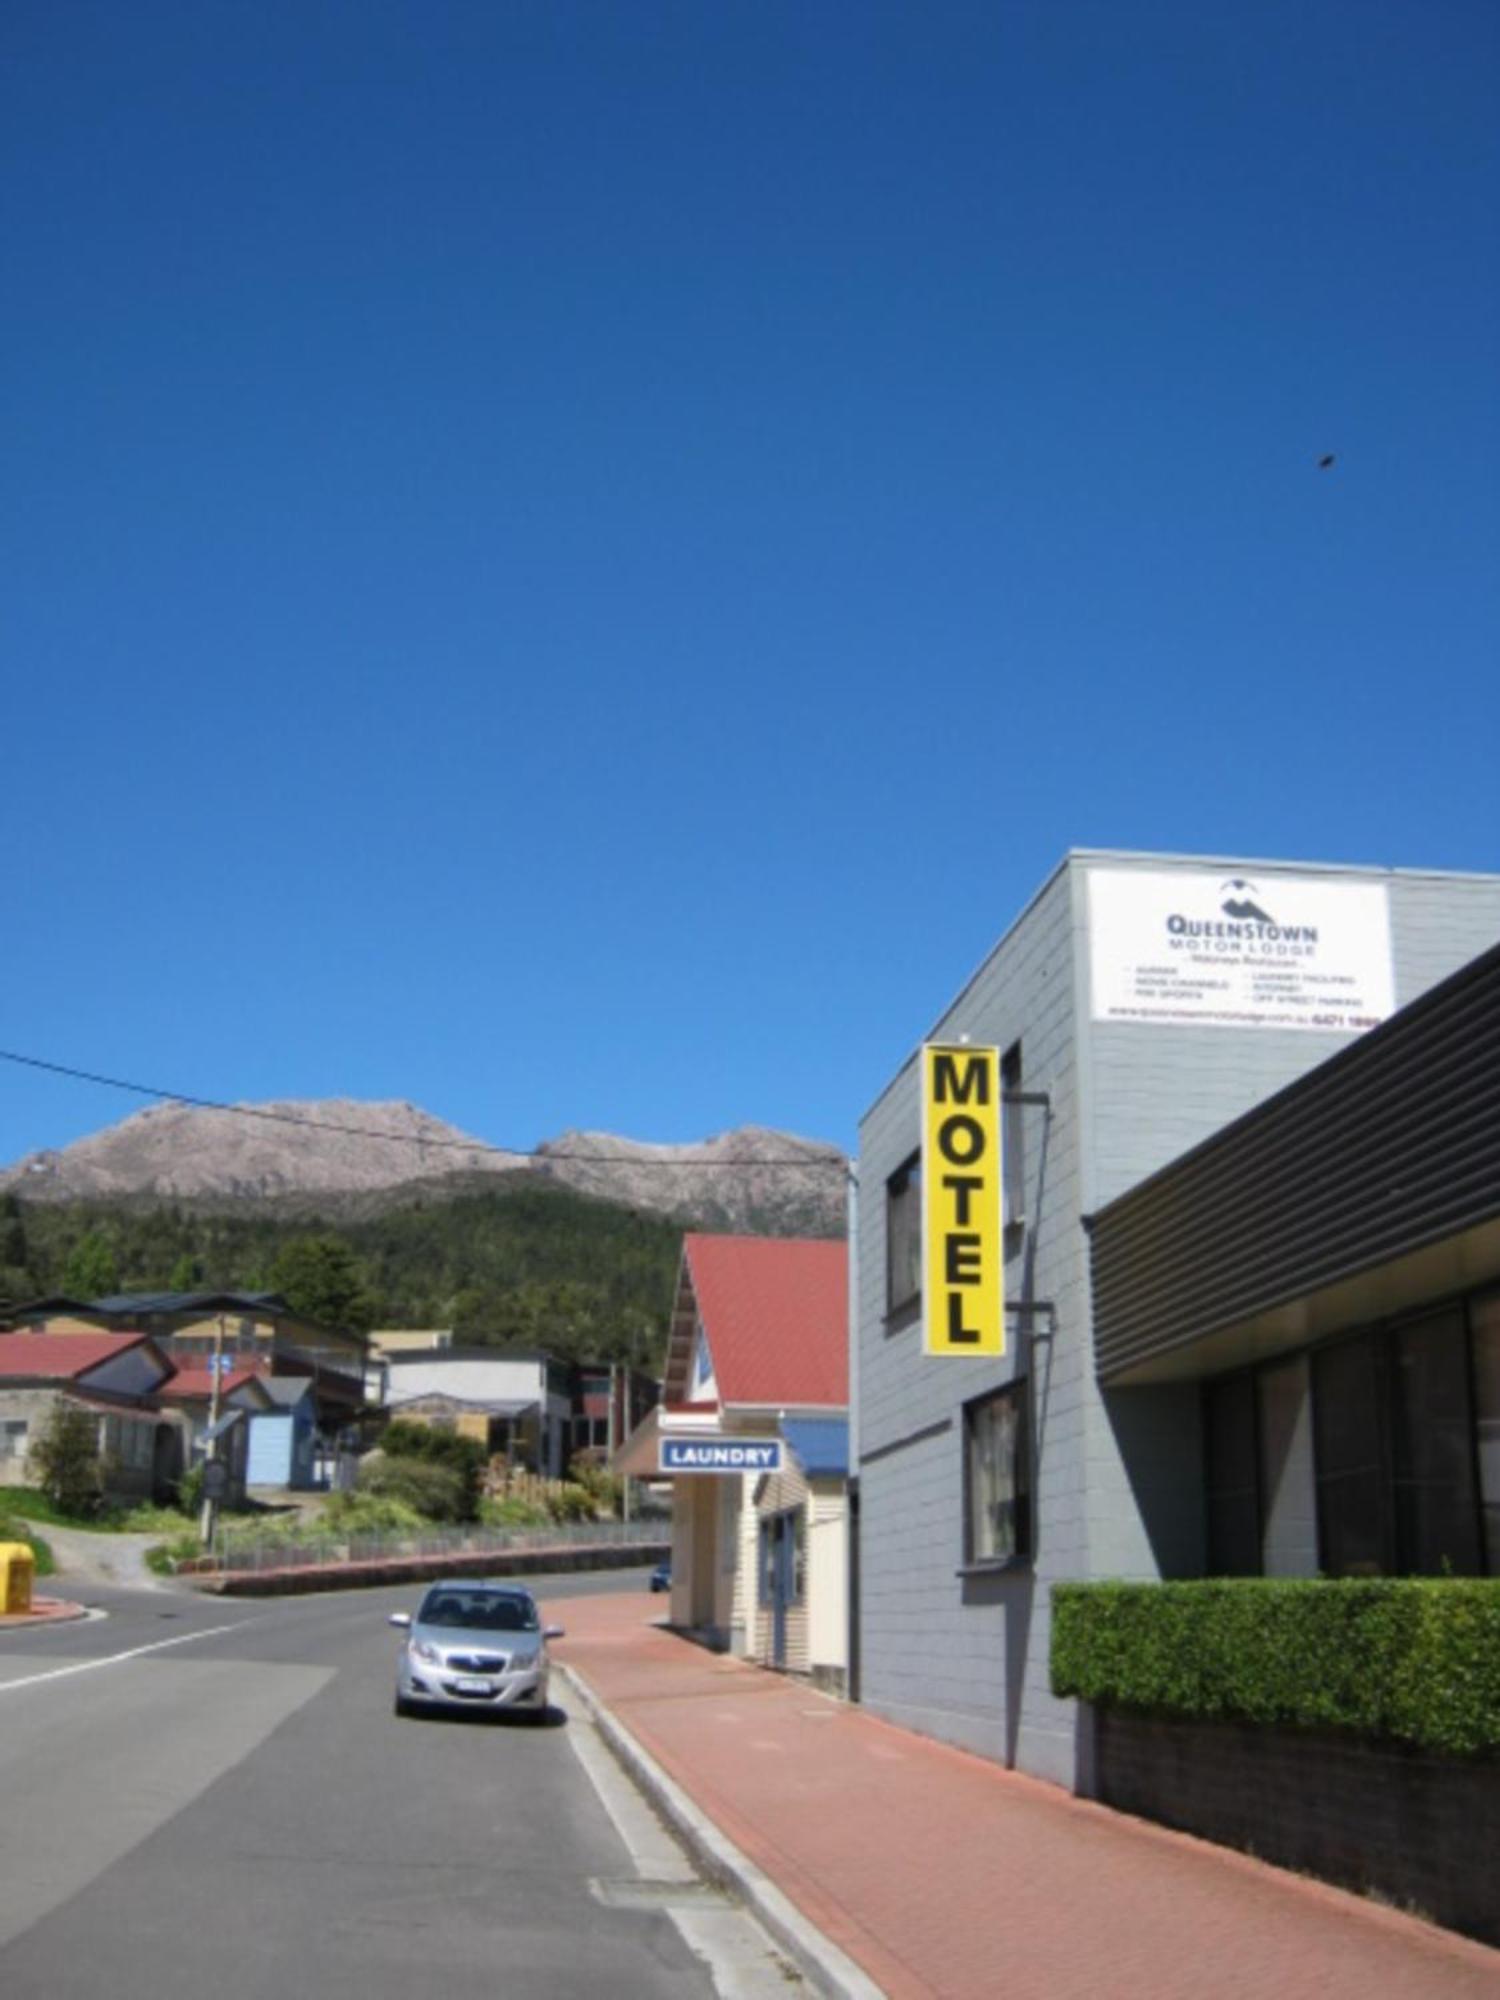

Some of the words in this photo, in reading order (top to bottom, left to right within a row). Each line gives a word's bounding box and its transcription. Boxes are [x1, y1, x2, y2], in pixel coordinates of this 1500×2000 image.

[1167, 914, 1318, 942] QUEENSTOWN
[1169, 938, 1241, 952] MOTOR
[1249, 941, 1315, 956] LODGE
[932, 1054, 990, 1344] MOTEL
[671, 1446, 773, 1465] LAUNDRY
